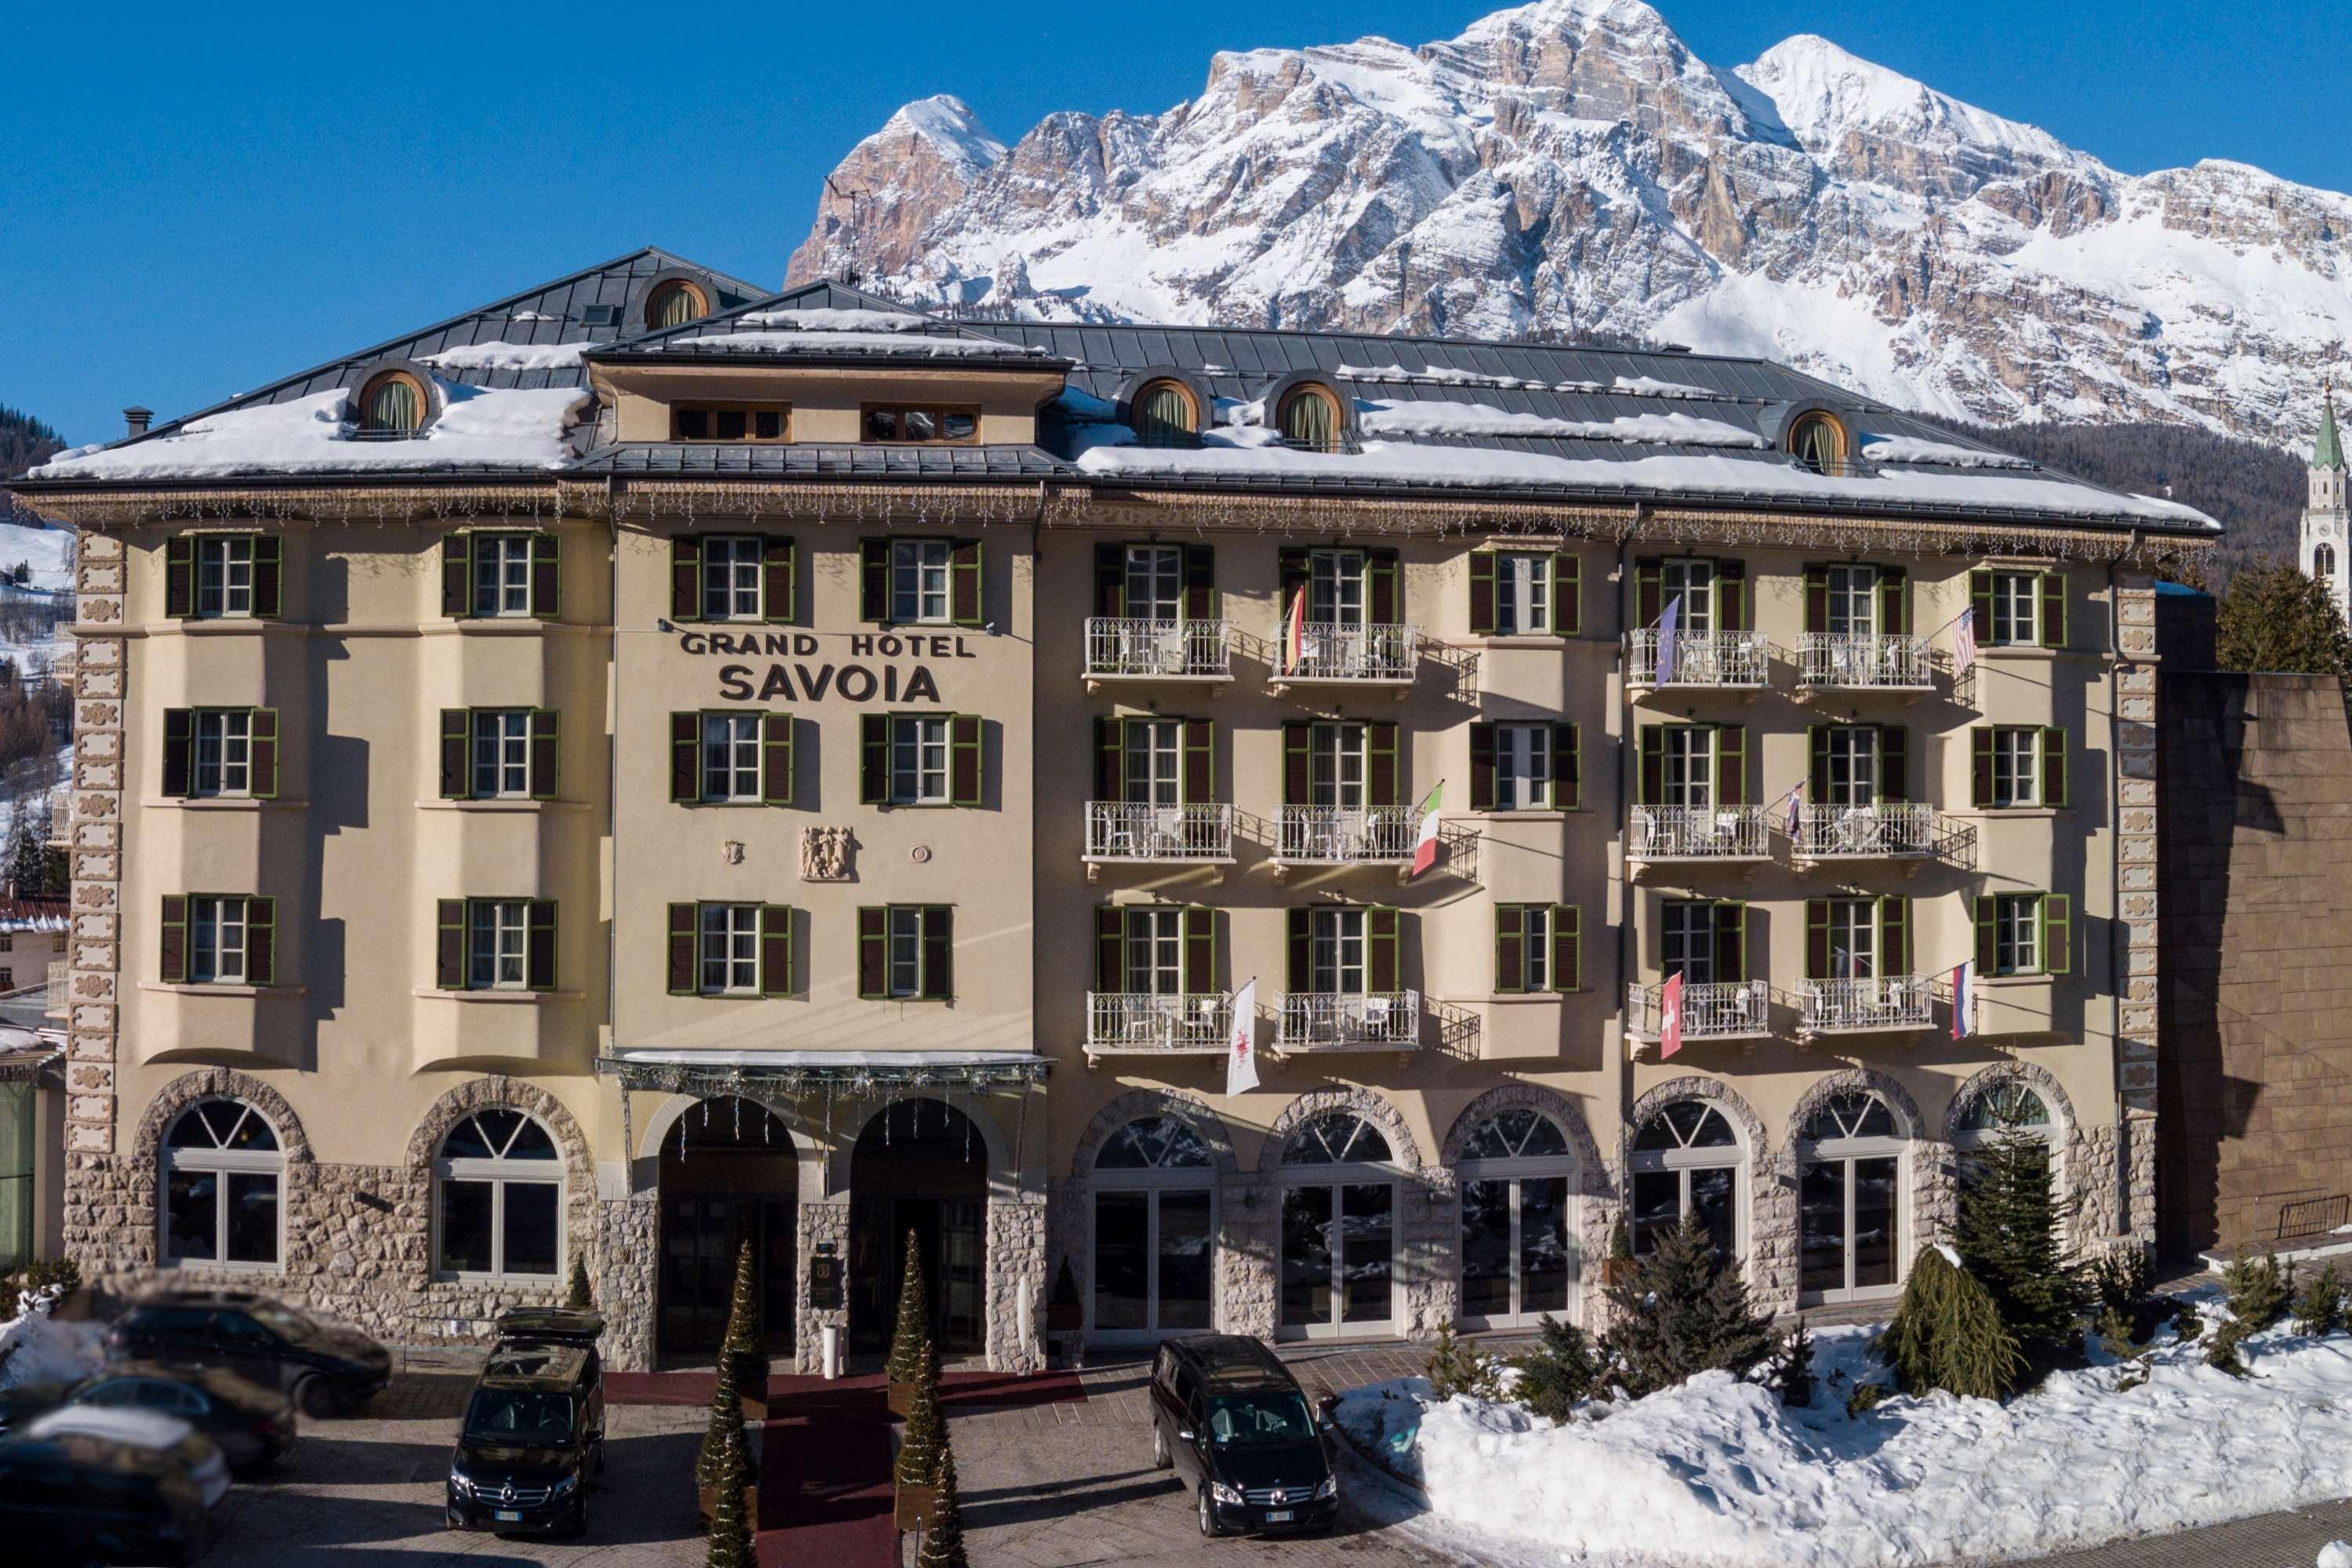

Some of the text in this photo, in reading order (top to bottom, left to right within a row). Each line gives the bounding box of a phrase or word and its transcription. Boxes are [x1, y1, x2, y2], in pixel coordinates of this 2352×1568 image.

[680, 633, 976, 658] GRAND HOTEL
[719, 663, 942, 702] SAVOIA
